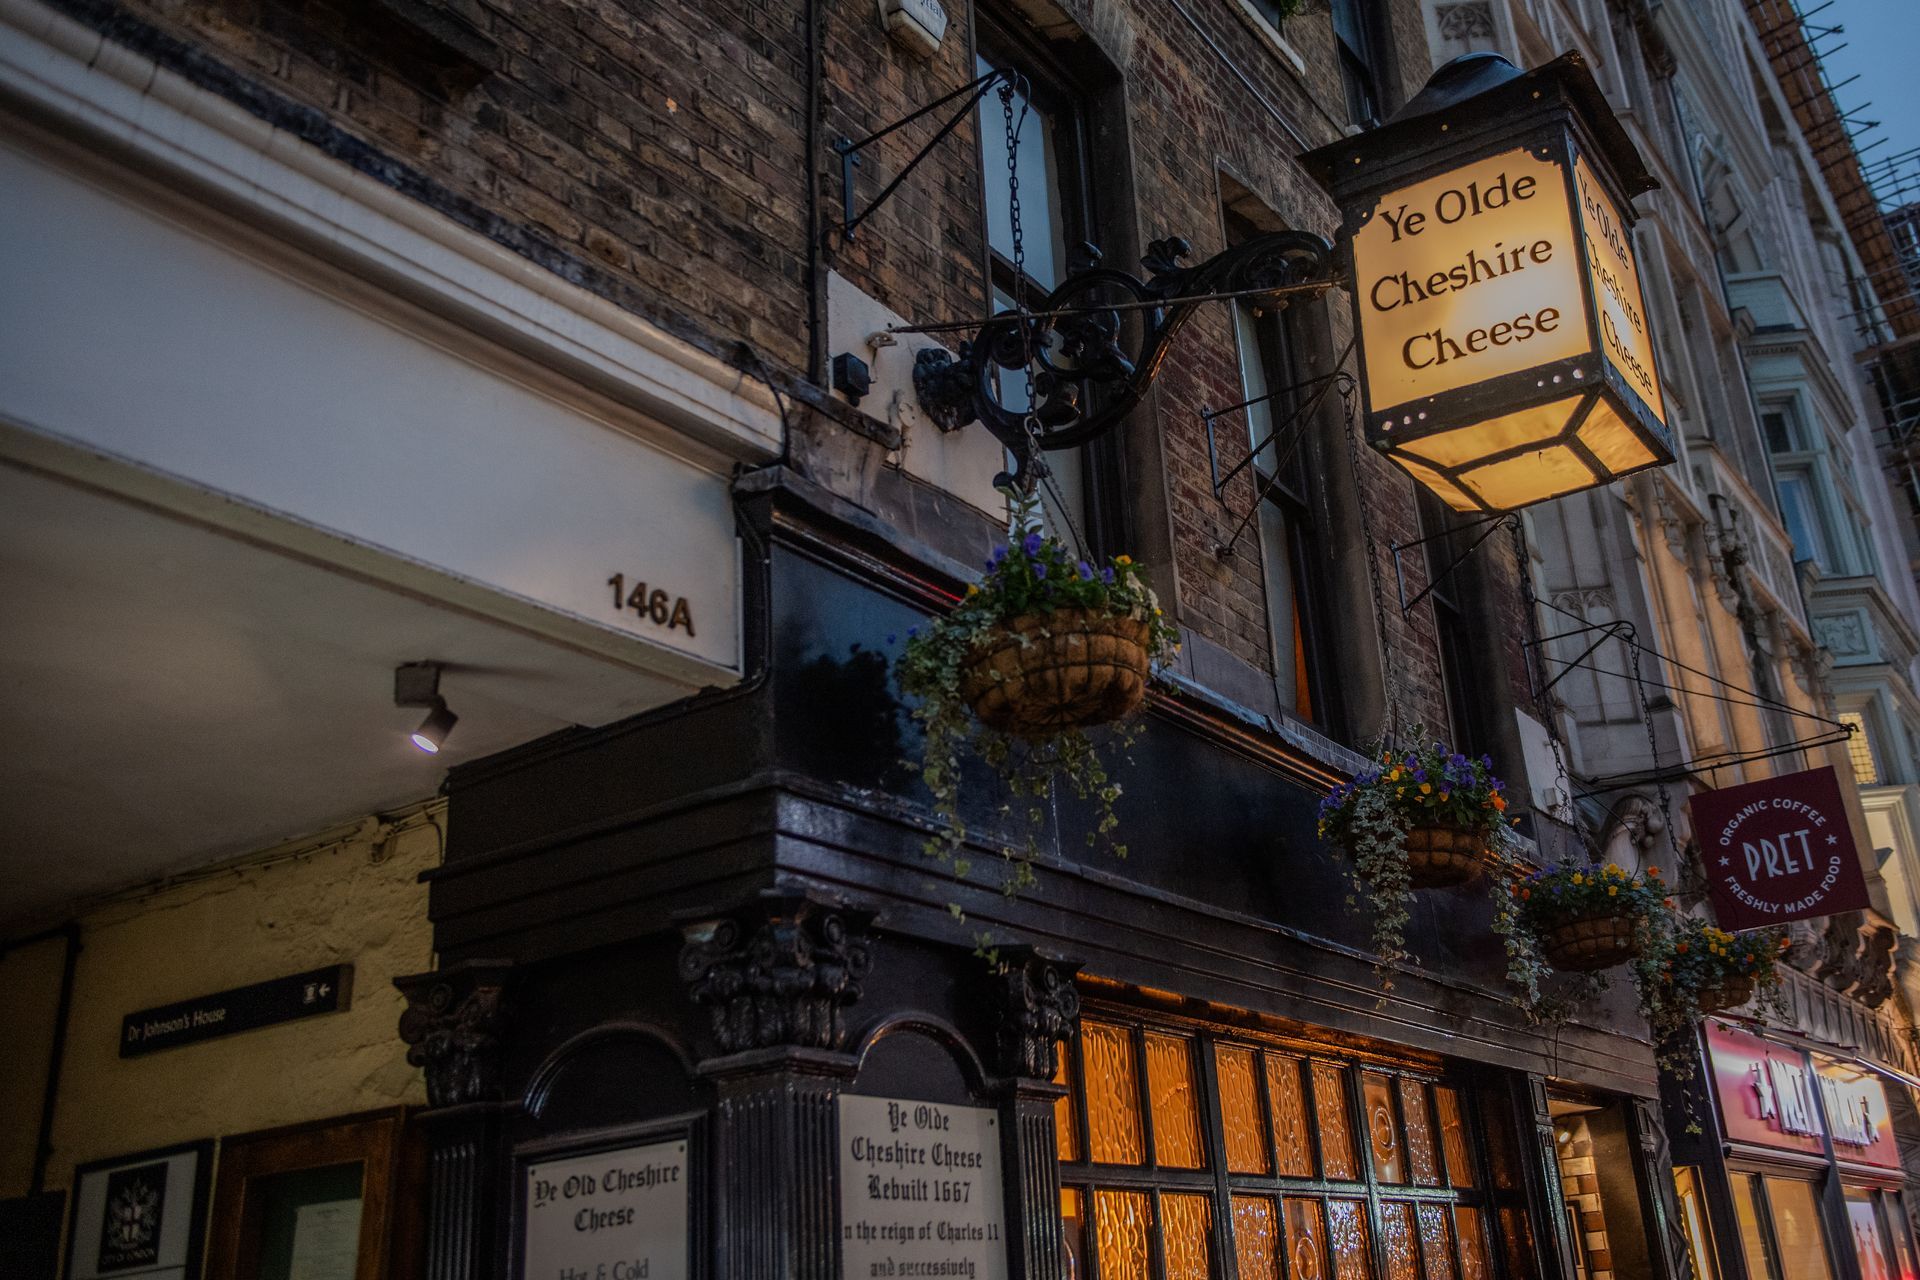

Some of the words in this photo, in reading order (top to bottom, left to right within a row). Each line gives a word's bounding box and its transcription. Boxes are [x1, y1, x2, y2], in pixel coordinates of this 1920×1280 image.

[1379, 204, 1426, 243] Ye
[1435, 172, 1537, 224] Olde
[1578, 170, 1596, 222] Ye
[1596, 204, 1629, 270] Olde
[1370, 240, 1552, 312] Cheshire
[1584, 231, 1642, 334] Cheshire
[1402, 307, 1560, 370] Cheese
[1603, 309, 1653, 396] Cheese
[607, 572, 696, 638] 146A
[1720, 800, 1768, 846] ORGANIC
[1772, 798, 1826, 827] COFFEE
[1742, 829, 1815, 881] PRET
[1724, 876, 1780, 914] FRESHLY
[1784, 890, 1824, 914] MADE
[1820, 856, 1841, 891] FOOD
[128, 1024, 141, 1041] Dr
[143, 1013, 190, 1041] Johnson's
[192, 1008, 227, 1027] House
[888, 1102, 907, 1132] Ye
[915, 1104, 949, 1131] Olde
[851, 1136, 926, 1170] Cheshire
[931, 1142, 982, 1172] Cheese
[534, 1180, 557, 1208] Ye
[563, 1174, 596, 1199] Old
[602, 1163, 680, 1195] Cheshire
[868, 1174, 928, 1201] Rebuilt
[934, 1181, 971, 1203] 1667
[574, 1206, 635, 1234] Cheese
[857, 1220, 877, 1244] the
[881, 1221, 914, 1244] reign
[918, 1221, 932, 1240] of
[937, 1221, 983, 1244] Charles
[612, 1257, 650, 1280] Cold
[871, 1256, 895, 1278] and
